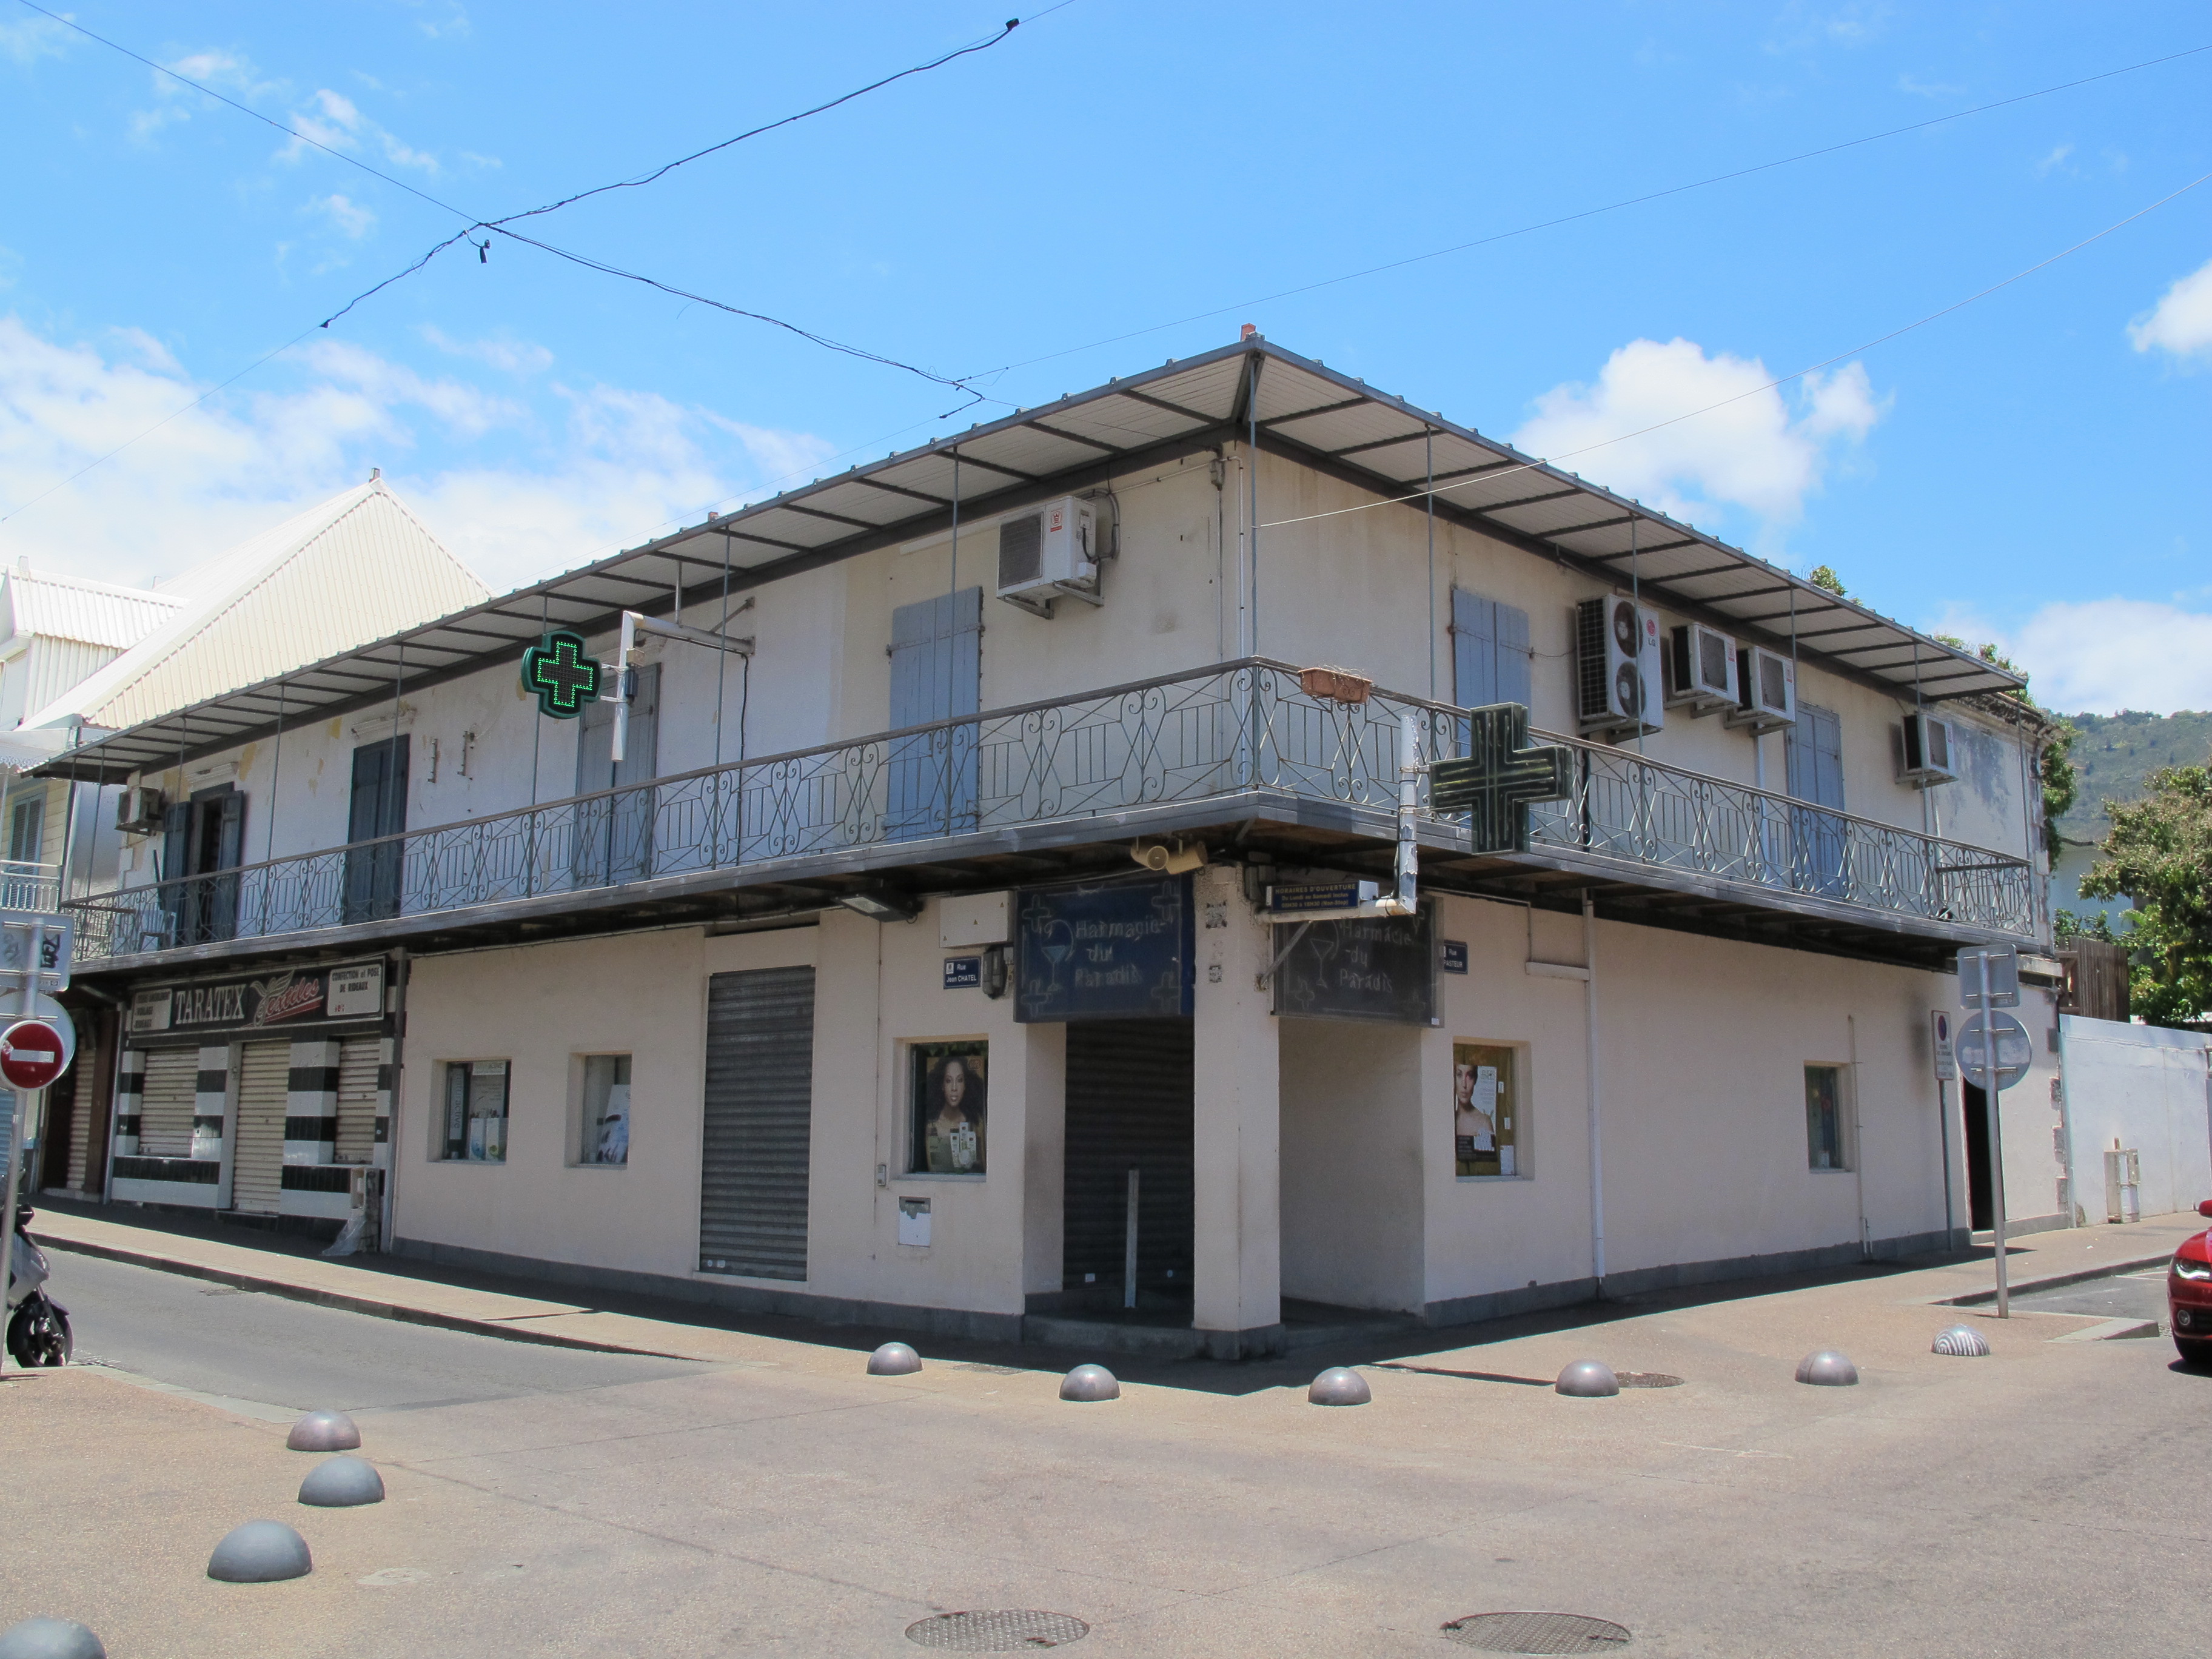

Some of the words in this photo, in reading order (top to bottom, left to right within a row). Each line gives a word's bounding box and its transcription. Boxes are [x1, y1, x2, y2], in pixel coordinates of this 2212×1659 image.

[1648, 638, 1656, 646] LG
[1310, 883, 1356, 892] D'OUVERTURE
[1350, 945, 1368, 967] du
[1075, 966, 1142, 988] Paradis
[1339, 968, 1393, 993] Paradis
[175, 984, 247, 1025] TARATEX
